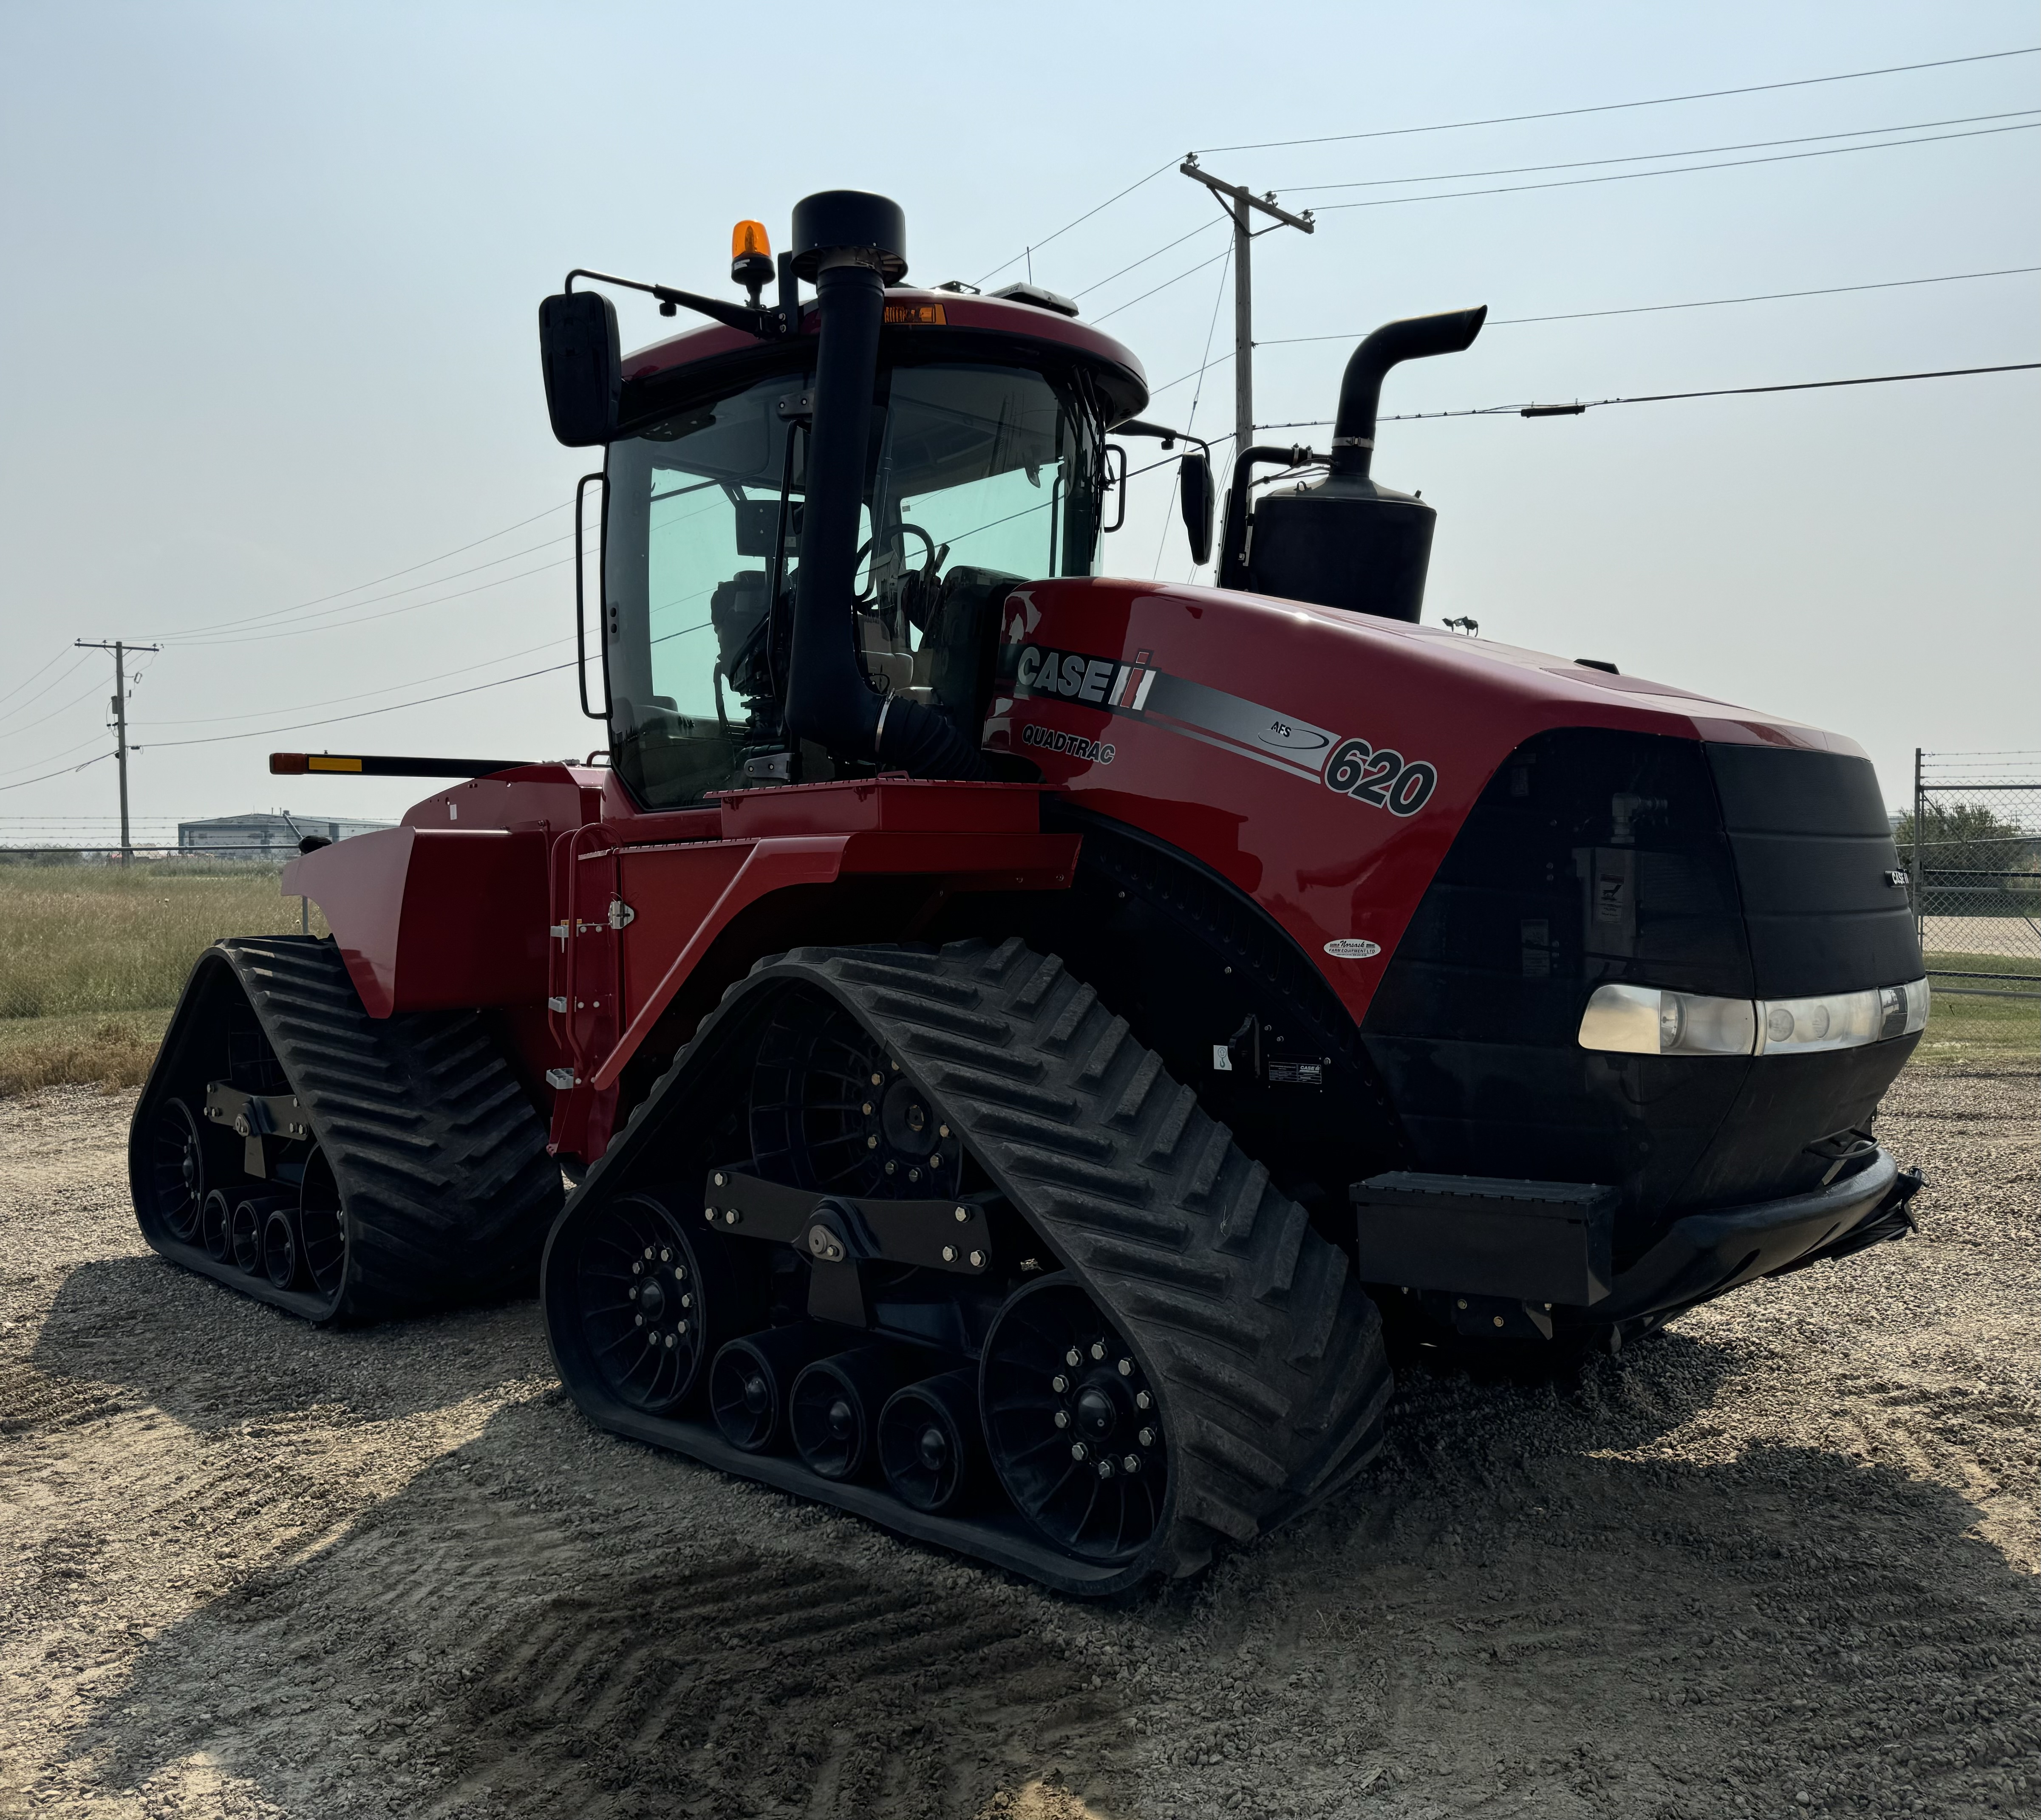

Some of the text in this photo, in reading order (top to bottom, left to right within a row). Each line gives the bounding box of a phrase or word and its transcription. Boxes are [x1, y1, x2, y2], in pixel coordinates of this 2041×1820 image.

[1017, 646, 1114, 703] CASE
[1022, 723, 1116, 765] QUADTRAC
[1270, 721, 1292, 738] AFS
[1324, 738, 1438, 817] 620
